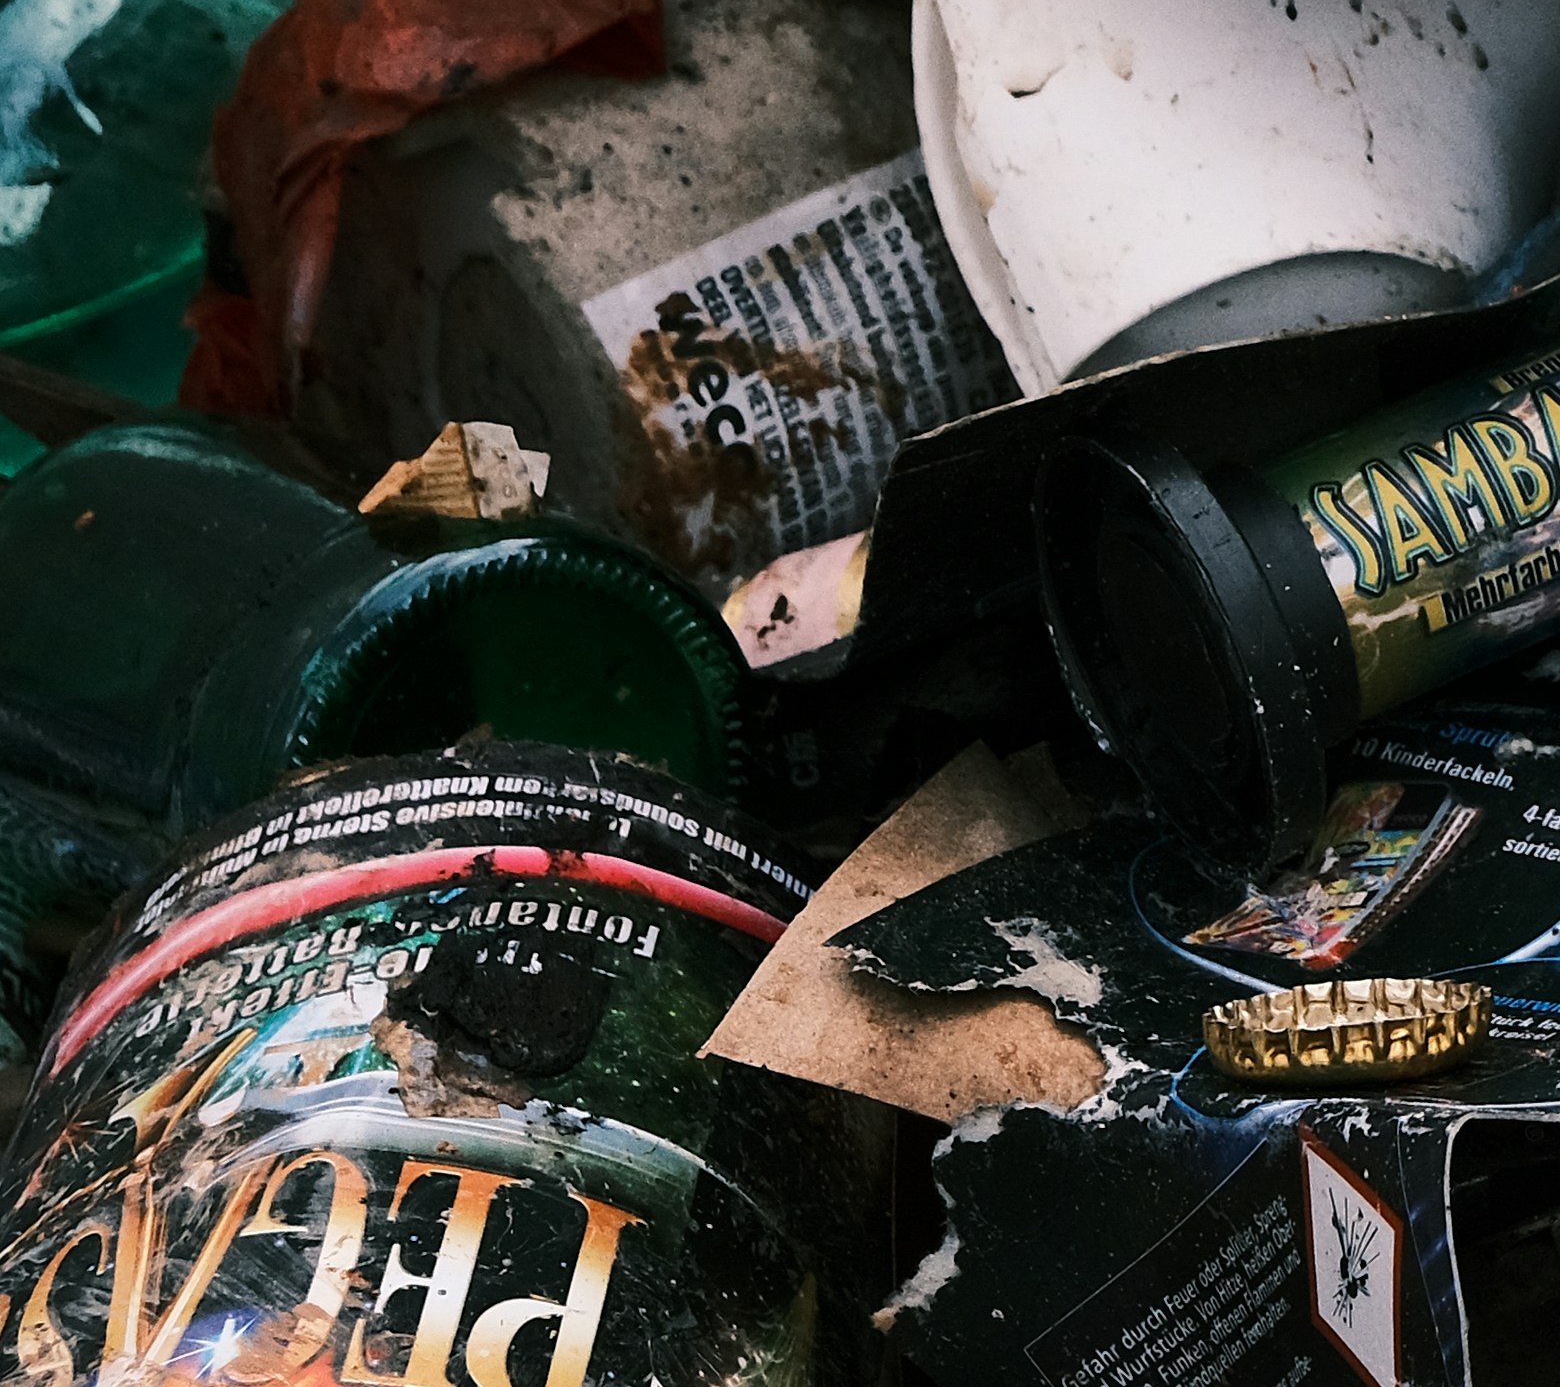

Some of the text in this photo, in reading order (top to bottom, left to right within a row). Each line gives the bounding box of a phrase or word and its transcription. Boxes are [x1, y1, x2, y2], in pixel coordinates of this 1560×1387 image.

[1380, 737, 1518, 795] Kinderfackeln,
[1109, 1311, 1201, 1387] Wurfstücke.
[1118, 1306, 1168, 1351] durch
[1163, 1279, 1202, 1314] Feuer
